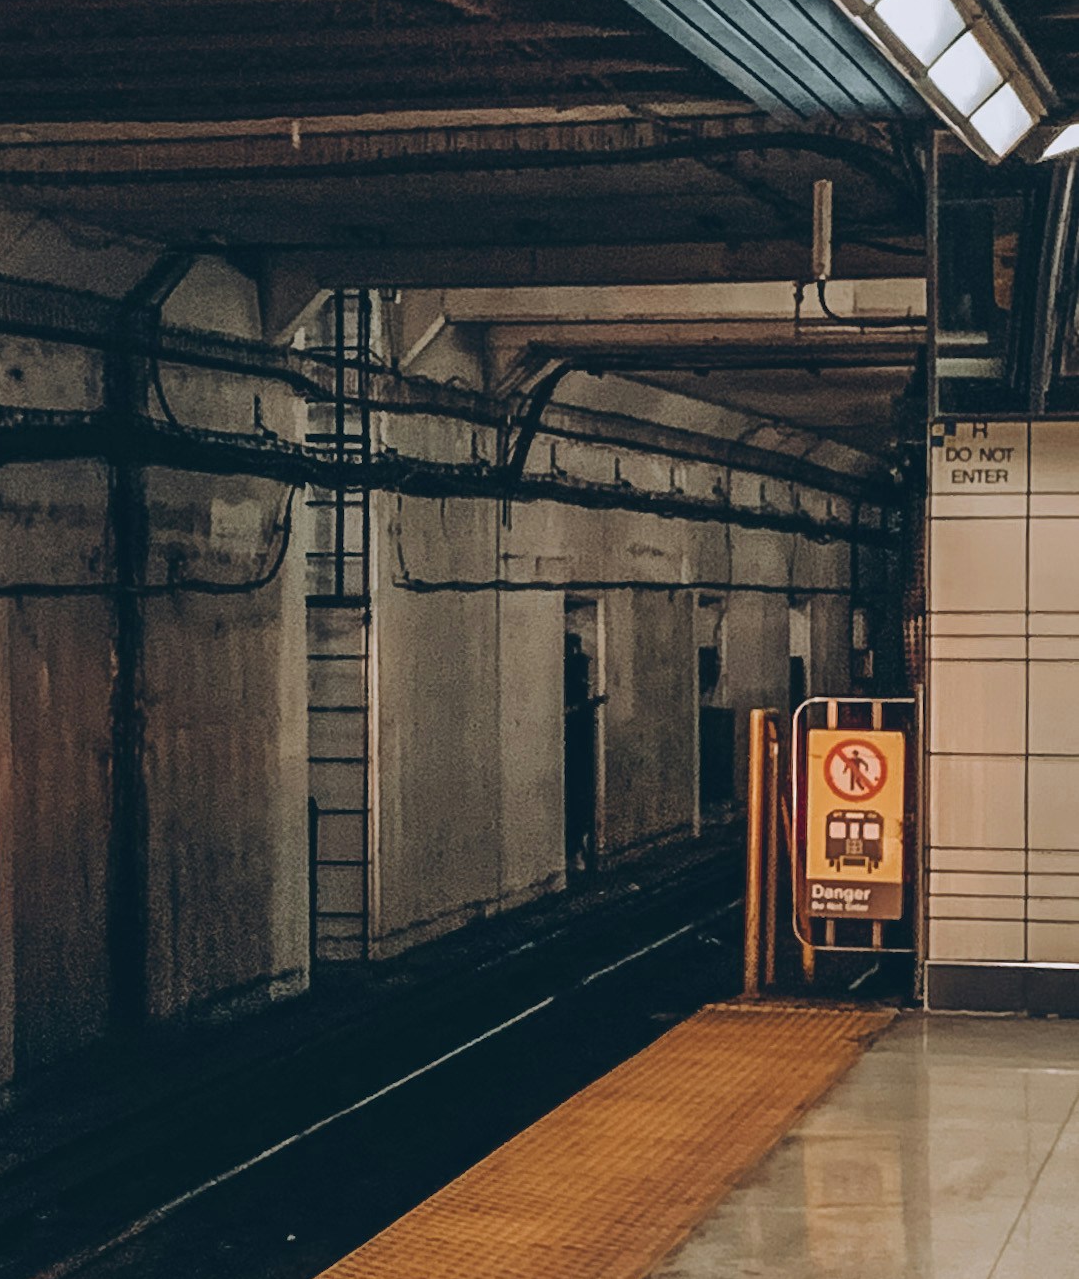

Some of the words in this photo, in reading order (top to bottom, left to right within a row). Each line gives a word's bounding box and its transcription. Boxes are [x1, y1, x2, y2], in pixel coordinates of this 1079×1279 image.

[946, 447, 972, 462] DO
[980, 447, 1014, 462] NOT
[952, 469, 1009, 483] ENTER
[811, 884, 871, 903] Danger
